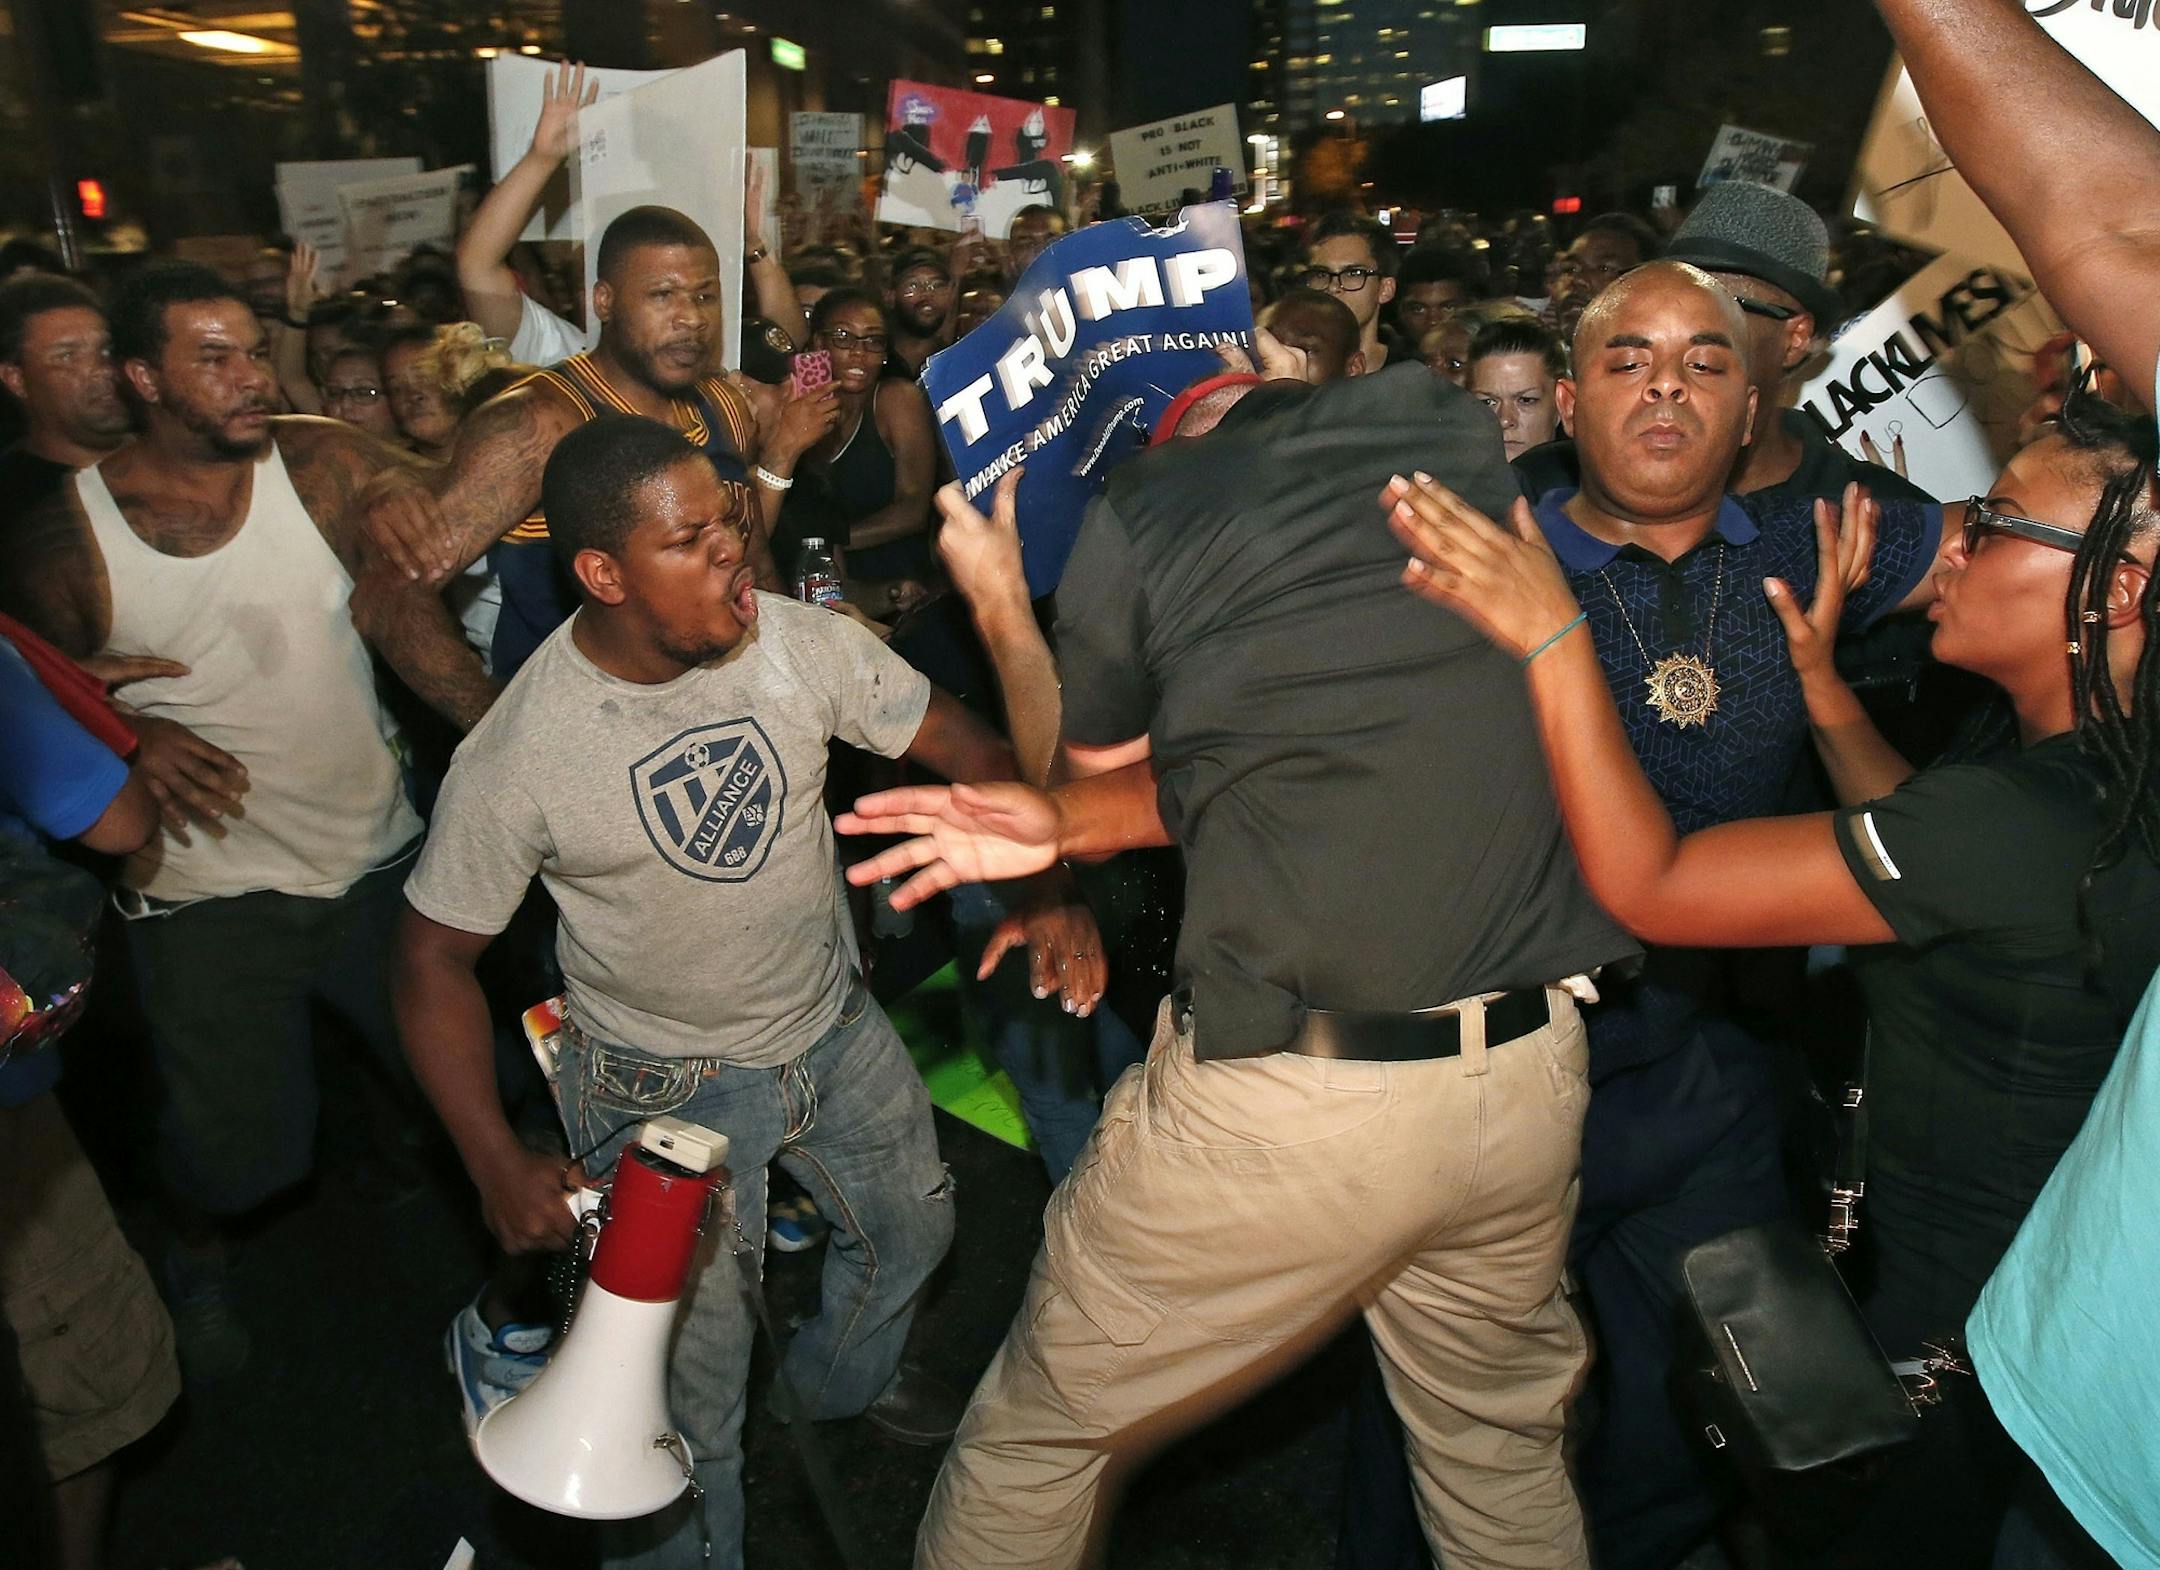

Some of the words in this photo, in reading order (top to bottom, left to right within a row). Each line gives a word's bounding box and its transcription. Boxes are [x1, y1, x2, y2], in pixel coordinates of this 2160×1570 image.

[1141, 127, 1164, 142] PRO
[1174, 116, 1215, 133] BLACK
[1160, 145, 1172, 156] IS
[1178, 139, 1201, 152] NOT
[1148, 155, 1222, 179] ANTI-WHITE
[938, 247, 1238, 446] TRUMP
[964, 440, 1028, 502] MAKE
[1034, 374, 1092, 451] AMERICA
[1087, 333, 1153, 380] GREAT
[1163, 330, 1250, 352] AGAIN!
[694, 758, 758, 858] ALLIANCE
[724, 846, 748, 867] 688
